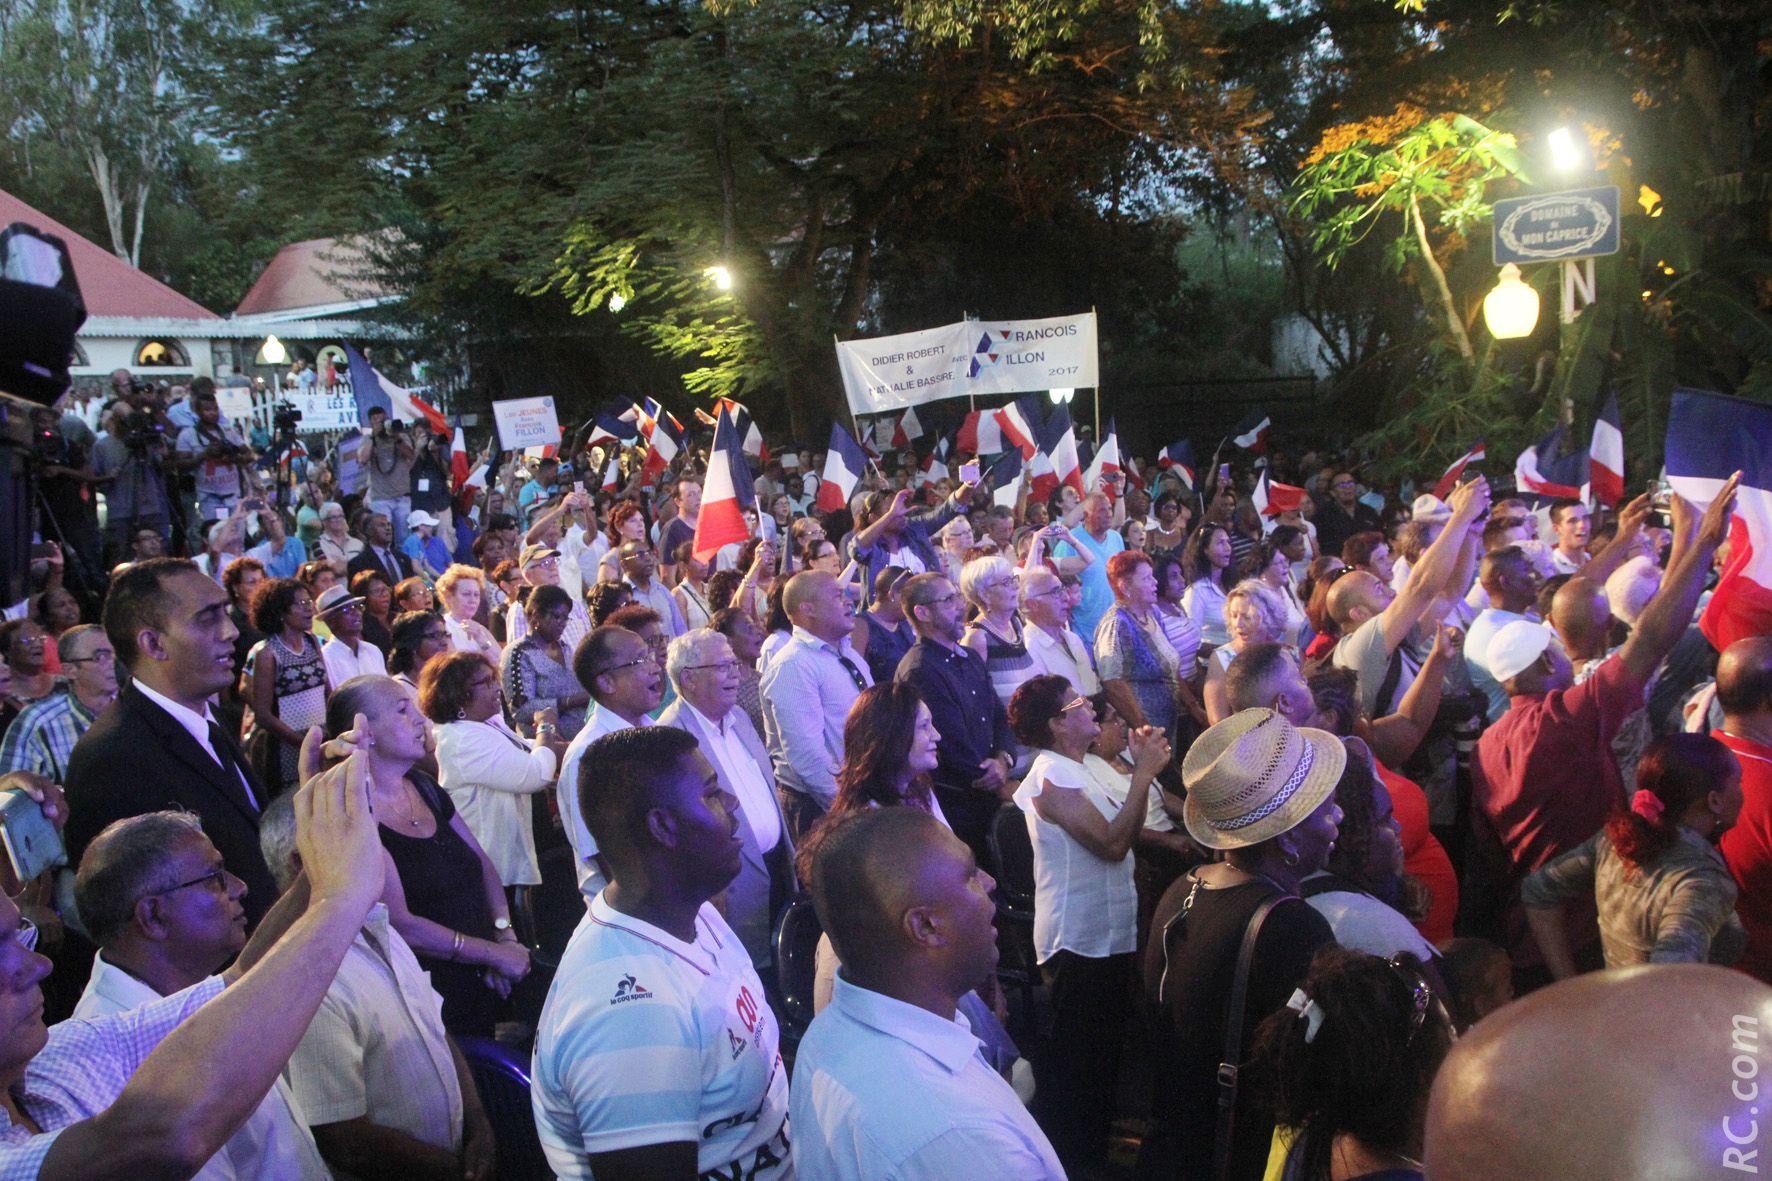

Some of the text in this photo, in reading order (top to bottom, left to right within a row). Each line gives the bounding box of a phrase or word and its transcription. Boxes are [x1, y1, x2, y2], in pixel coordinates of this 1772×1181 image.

[1531, 204, 1579, 222] DOMAINE
[1521, 226, 1590, 245] MON CAPRICE
[872, 345, 946, 367] DIDIER ROBERT
[906, 365, 914, 375] &
[1048, 366, 1080, 377] 2017
[327, 397, 344, 409] LES
[515, 427, 546, 437] FILLON
